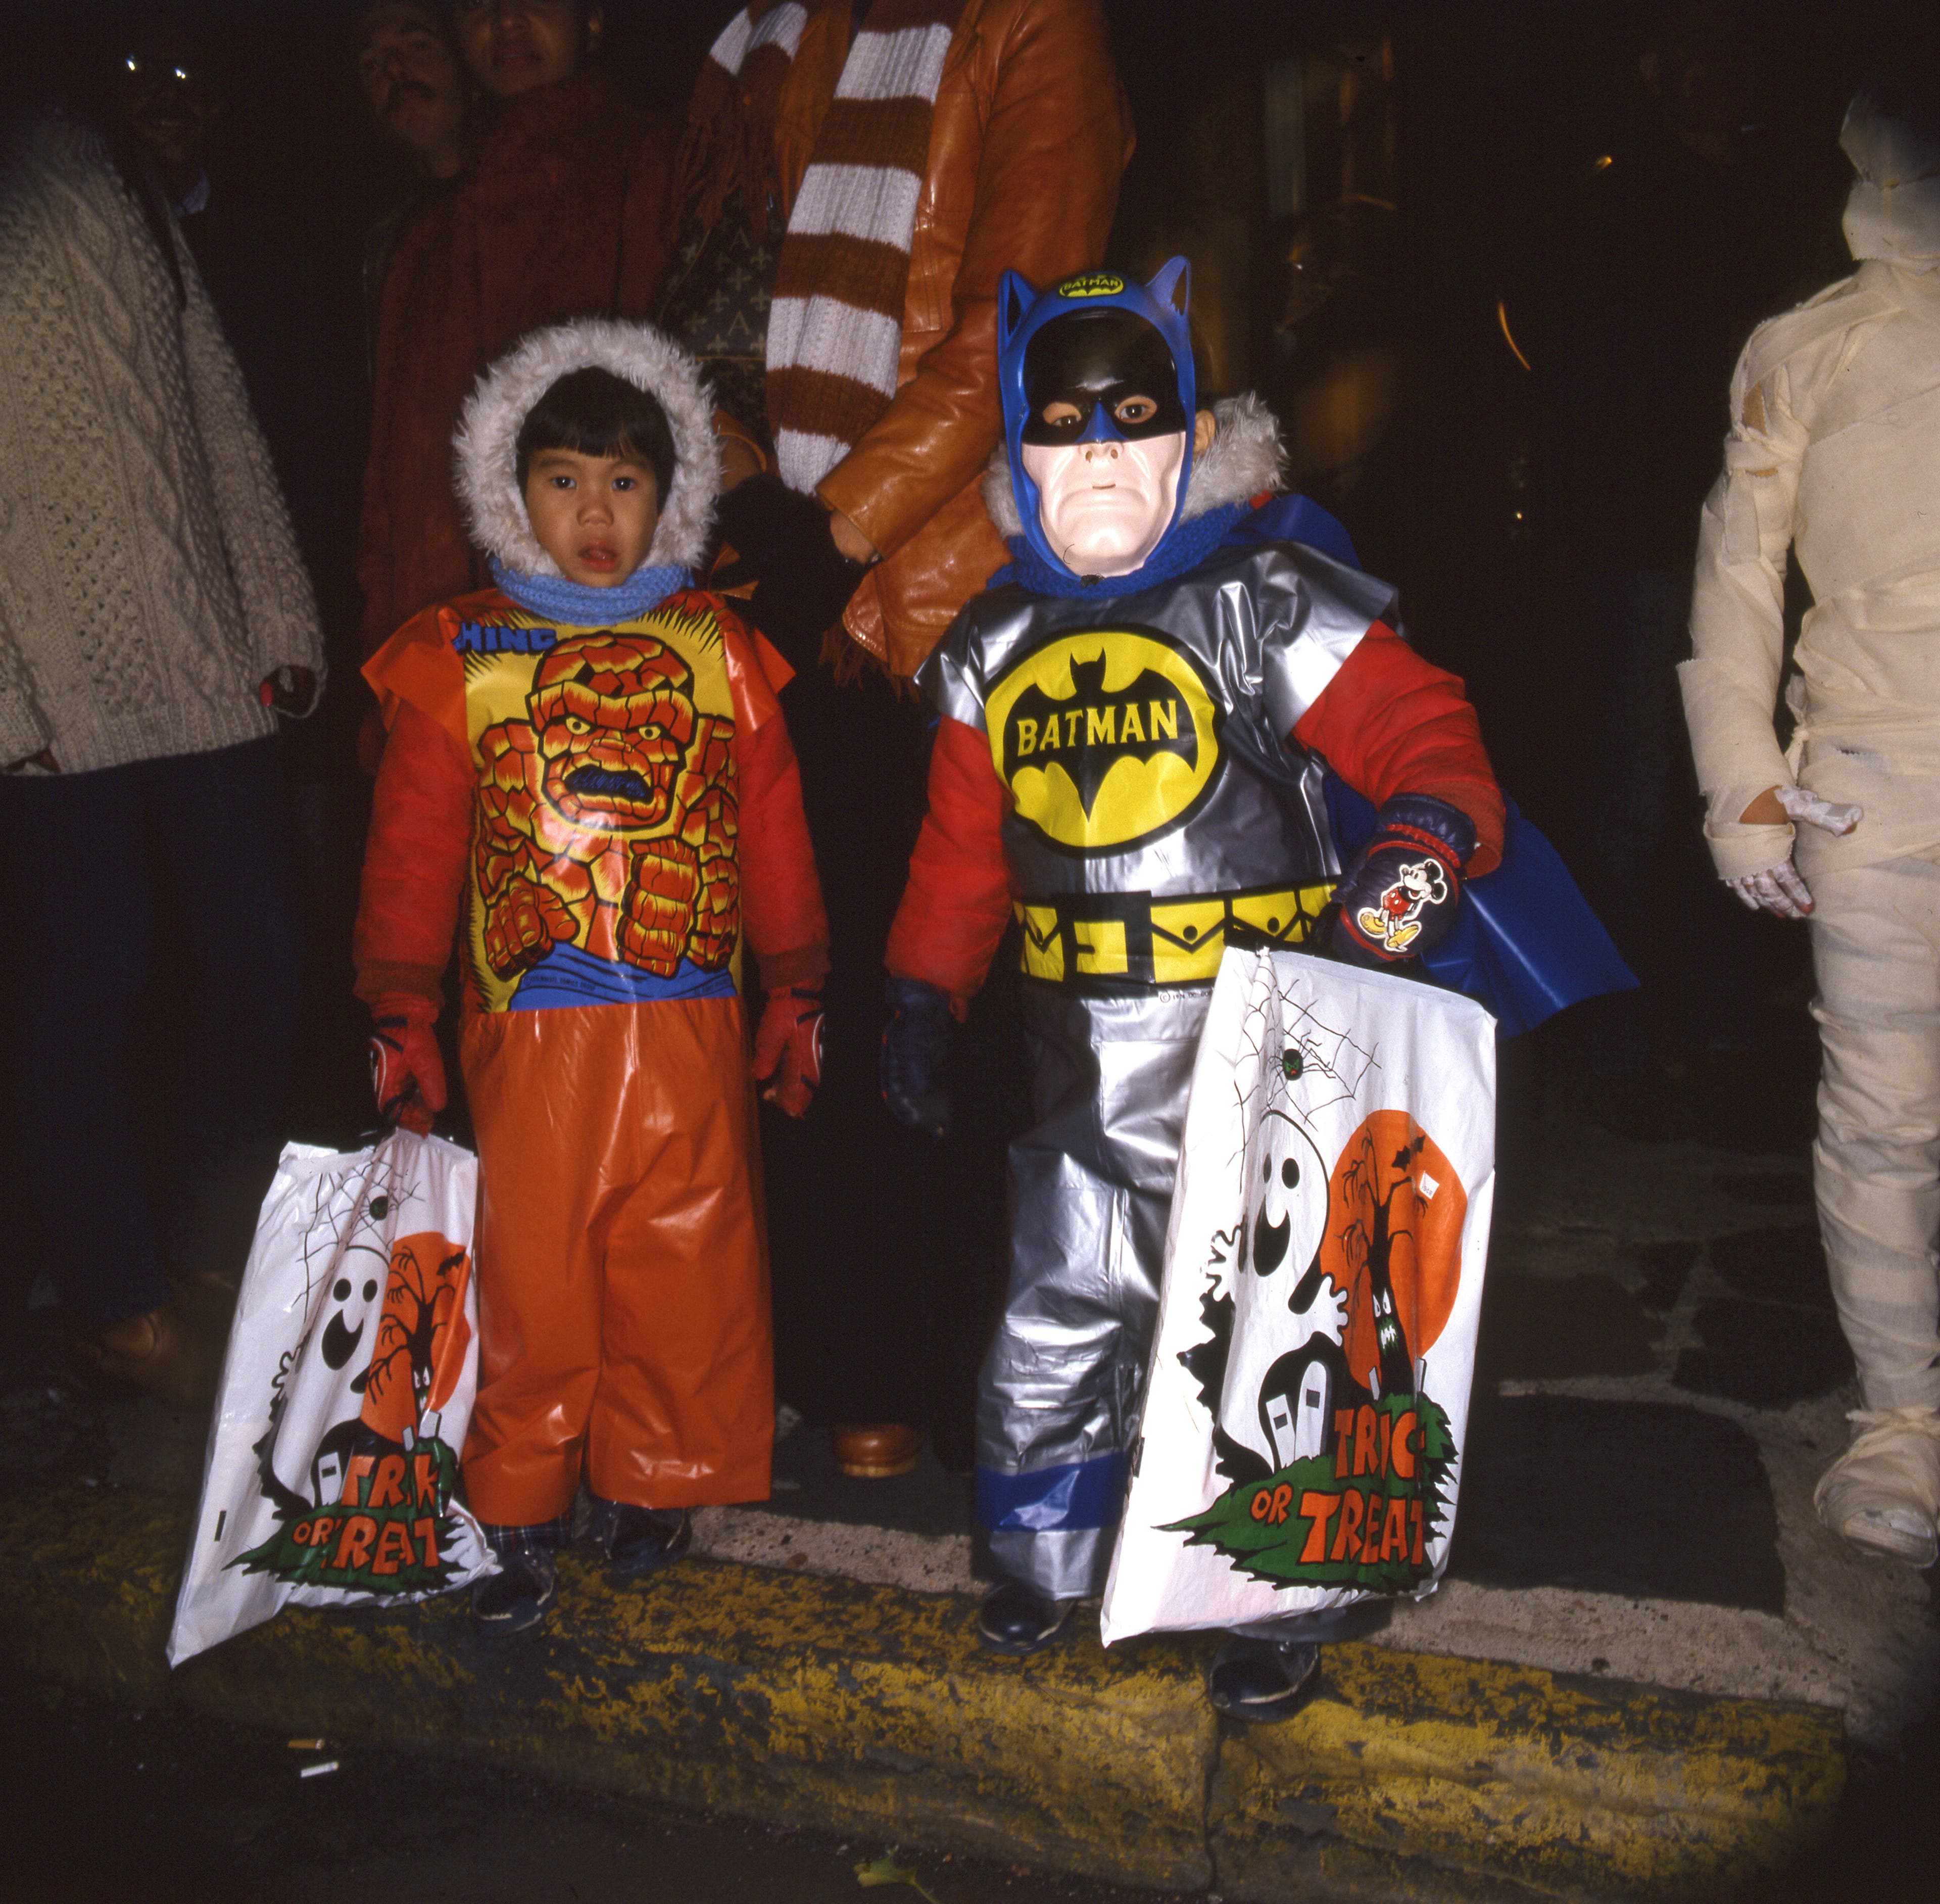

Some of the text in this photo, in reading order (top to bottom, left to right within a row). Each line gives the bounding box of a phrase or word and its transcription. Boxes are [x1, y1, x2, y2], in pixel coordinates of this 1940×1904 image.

[1063, 278, 1119, 291] BATMAN
[452, 622, 557, 652] HING
[1016, 699, 1179, 757] BATMAN
[1334, 1404, 1425, 1481] TRIC
[292, 1515, 439, 1575] OR REAT
[1250, 1483, 1424, 1565] OR TREAT
